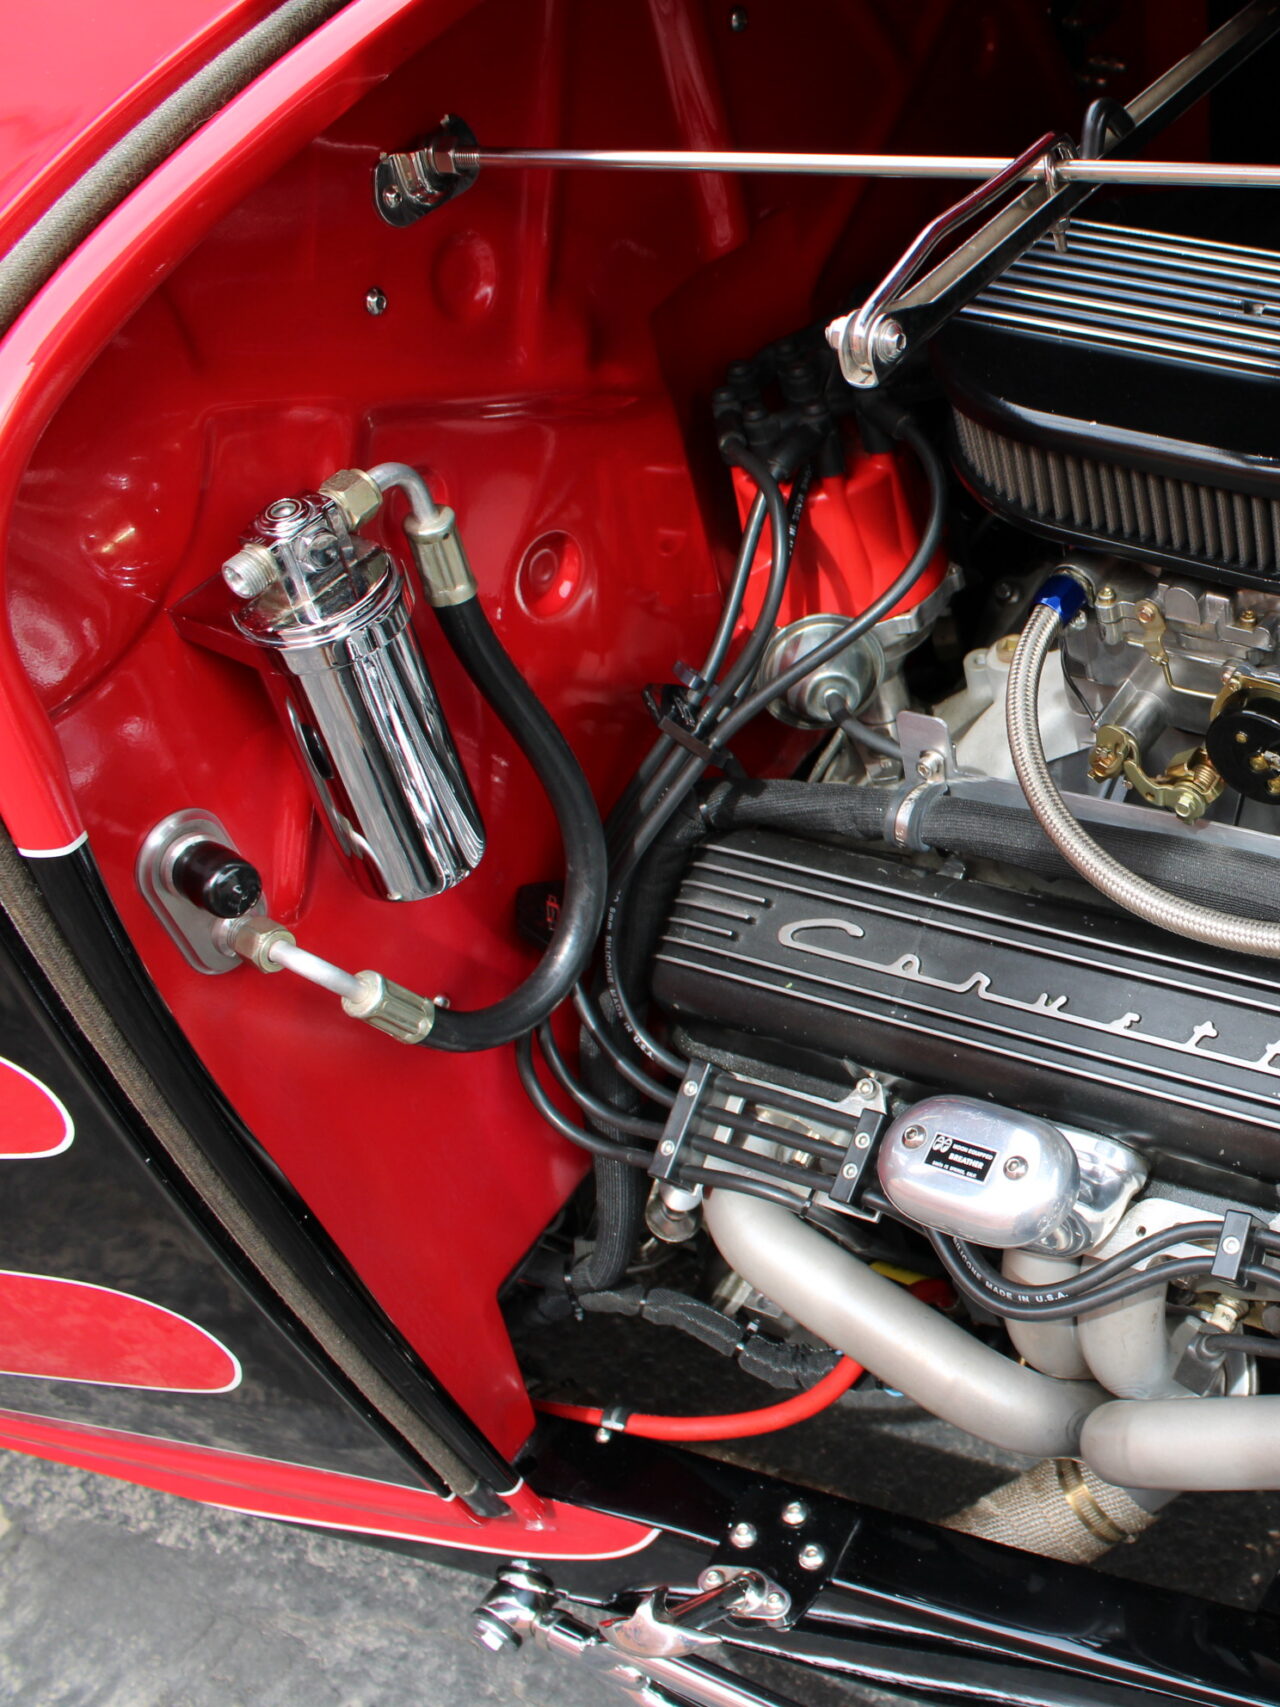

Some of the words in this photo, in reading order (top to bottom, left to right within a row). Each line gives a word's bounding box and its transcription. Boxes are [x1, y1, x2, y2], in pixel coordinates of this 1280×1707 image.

[947, 1152, 985, 1170] BREATHER
[985, 1280, 1013, 1300] MADE
[1018, 1294, 1030, 1303] IN
[1035, 1290, 1069, 1303] U.S.A.
